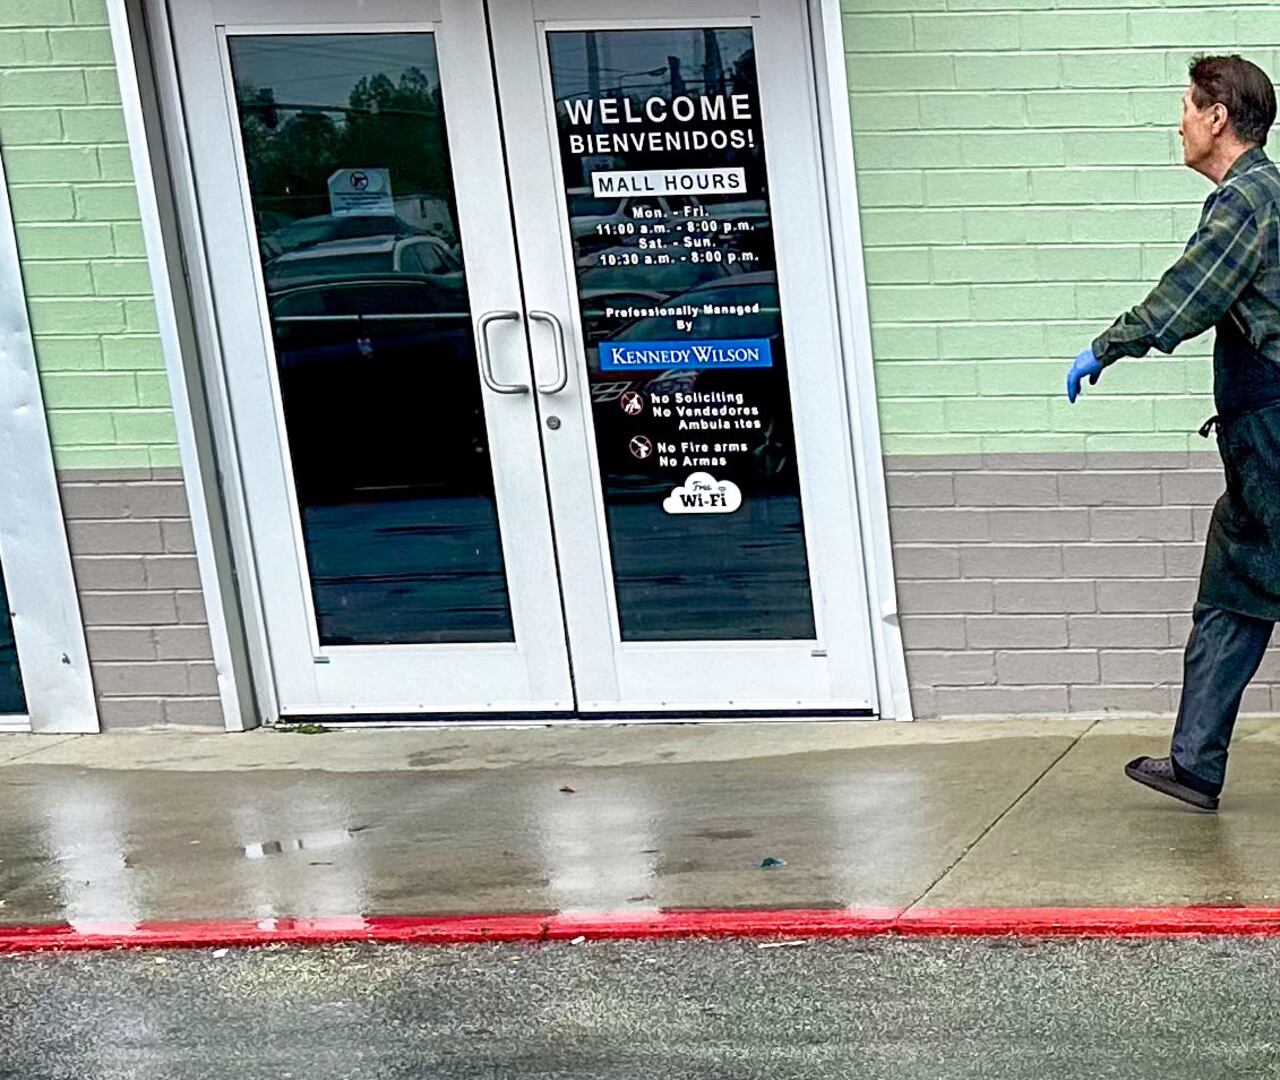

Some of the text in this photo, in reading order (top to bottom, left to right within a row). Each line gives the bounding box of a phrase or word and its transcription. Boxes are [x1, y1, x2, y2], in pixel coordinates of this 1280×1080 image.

[564, 94, 752, 125] WELCOME
[569, 129, 755, 154] BIENVENIDOS!
[598, 174, 740, 192] MALL HOURS
[632, 206, 668, 218] Mon.
[683, 205, 710, 217] Fri.
[596, 223, 635, 235] 11:00
[640, 224, 671, 234] a.m.
[687, 220, 718, 232] 8:00
[723, 221, 755, 233] p.m.
[638, 237, 667, 249] Sat.
[683, 236, 716, 248] Sun.
[600, 253, 639, 265] 10:30
[644, 254, 675, 264] a.m.
[691, 251, 722, 263] 8:00
[727, 251, 759, 264] p.m.
[606, 303, 760, 318] Professionally Managed
[676, 320, 693, 332] By
[611, 346, 759, 364] KENNEDY WILSON
[650, 391, 744, 405] No Soliciting
[652, 405, 759, 417] No Vendedores
[657, 441, 748, 453] No Fire arms
[659, 455, 727, 467] No Armas
[680, 493, 727, 507] Wi-Fi
